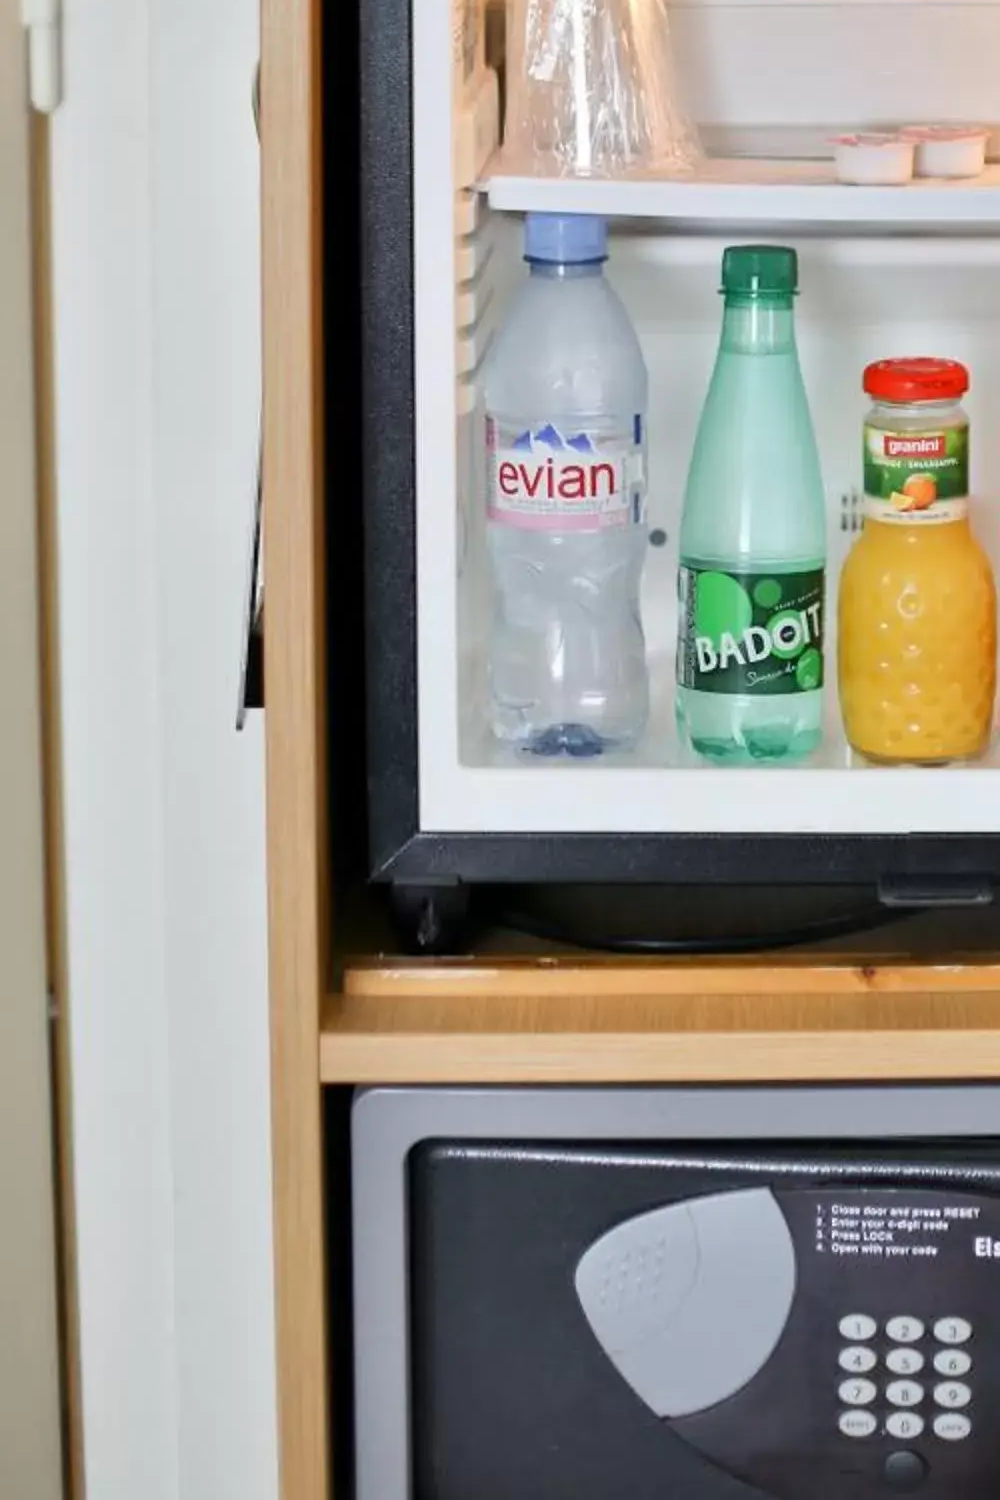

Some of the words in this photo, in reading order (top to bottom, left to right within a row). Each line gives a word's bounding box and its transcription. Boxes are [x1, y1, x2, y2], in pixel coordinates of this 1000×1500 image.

[888, 436, 941, 454] granini
[499, 457, 615, 498] evian
[695, 602, 821, 673] BADOIT
[831, 1204, 861, 1215] Close
[863, 1206, 887, 1216] door
[890, 1206, 909, 1217] and
[912, 1207, 941, 1219] press
[943, 1207, 980, 1219] RESET
[831, 1218, 859, 1228] Enter
[861, 1219, 885, 1231] your
[923, 1221, 949, 1231] code
[831, 1230, 860, 1241] Press
[863, 1231, 893, 1242] LOCK
[831, 1243, 859, 1255] Open
[861, 1243, 883, 1254] with
[886, 1245, 910, 1257] your
[912, 1246, 938, 1257] code
